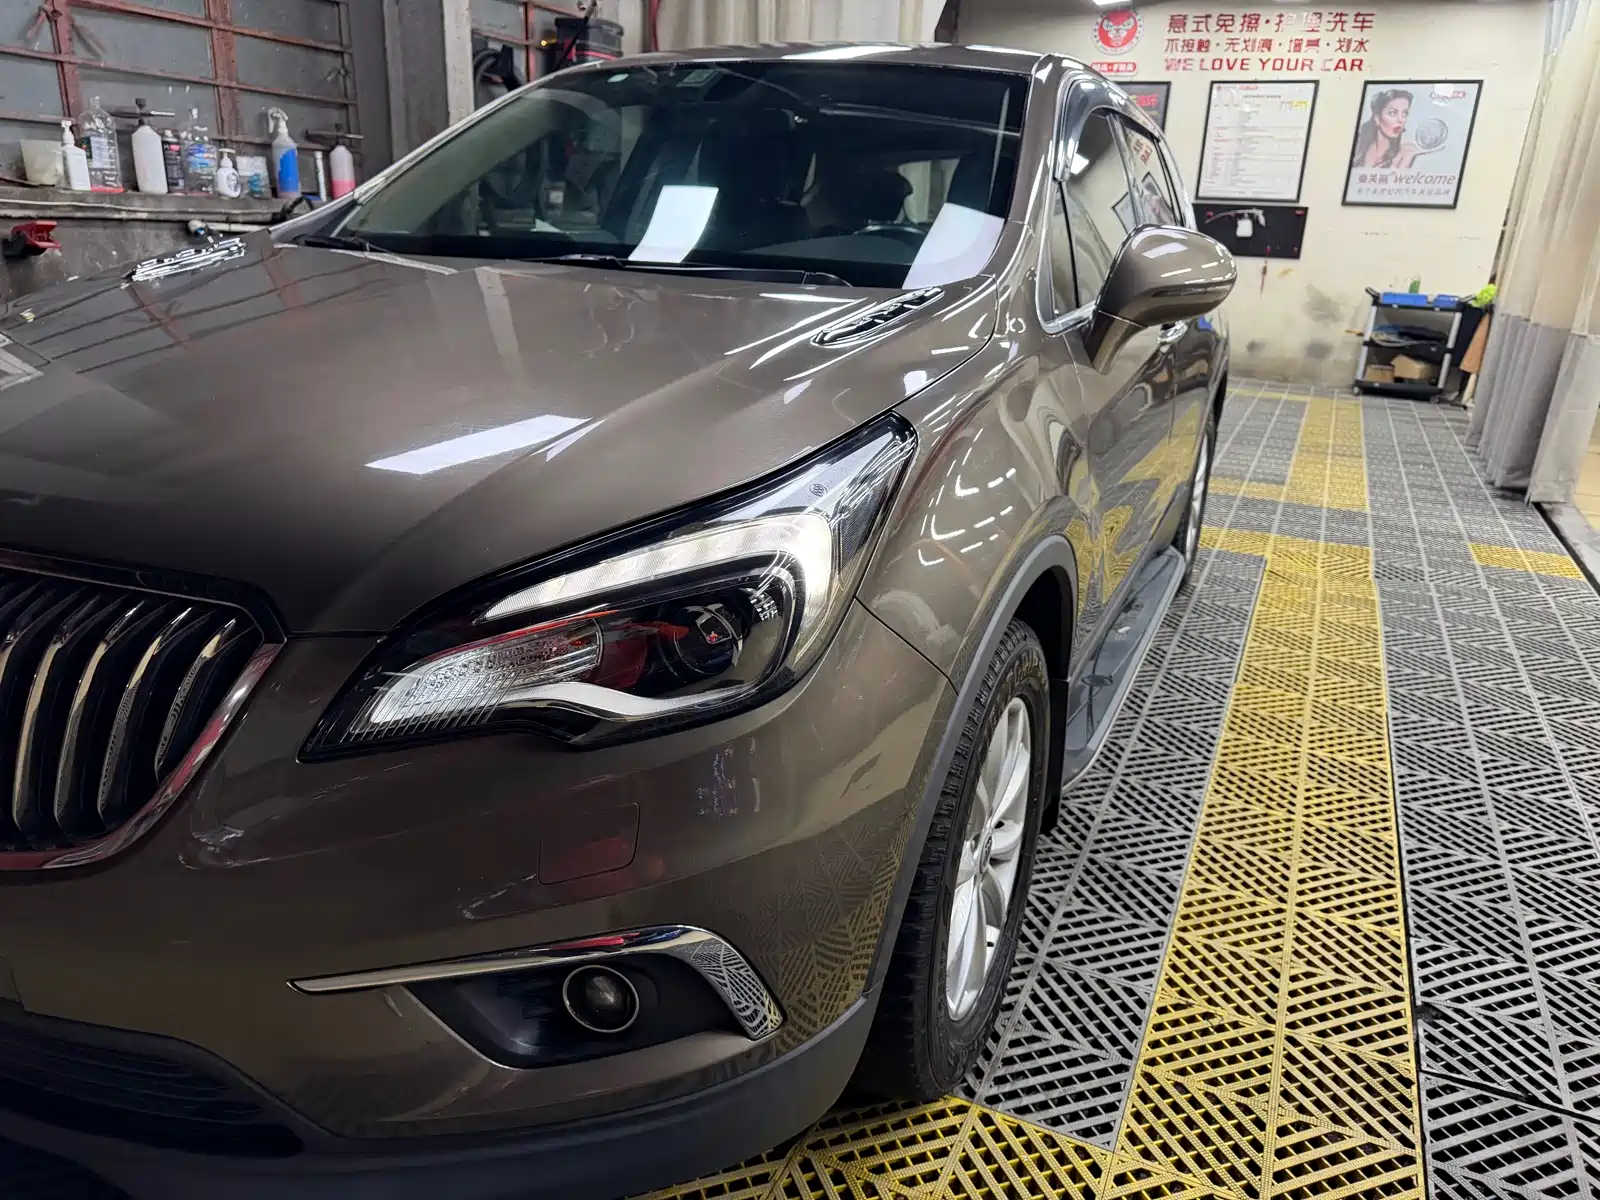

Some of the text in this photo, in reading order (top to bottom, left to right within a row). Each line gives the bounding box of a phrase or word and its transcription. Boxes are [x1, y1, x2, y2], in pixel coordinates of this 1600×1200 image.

[1199, 58, 1251, 71] LOVE
[1258, 58, 1314, 71] YOUR
[1320, 58, 1364, 71] CAR
